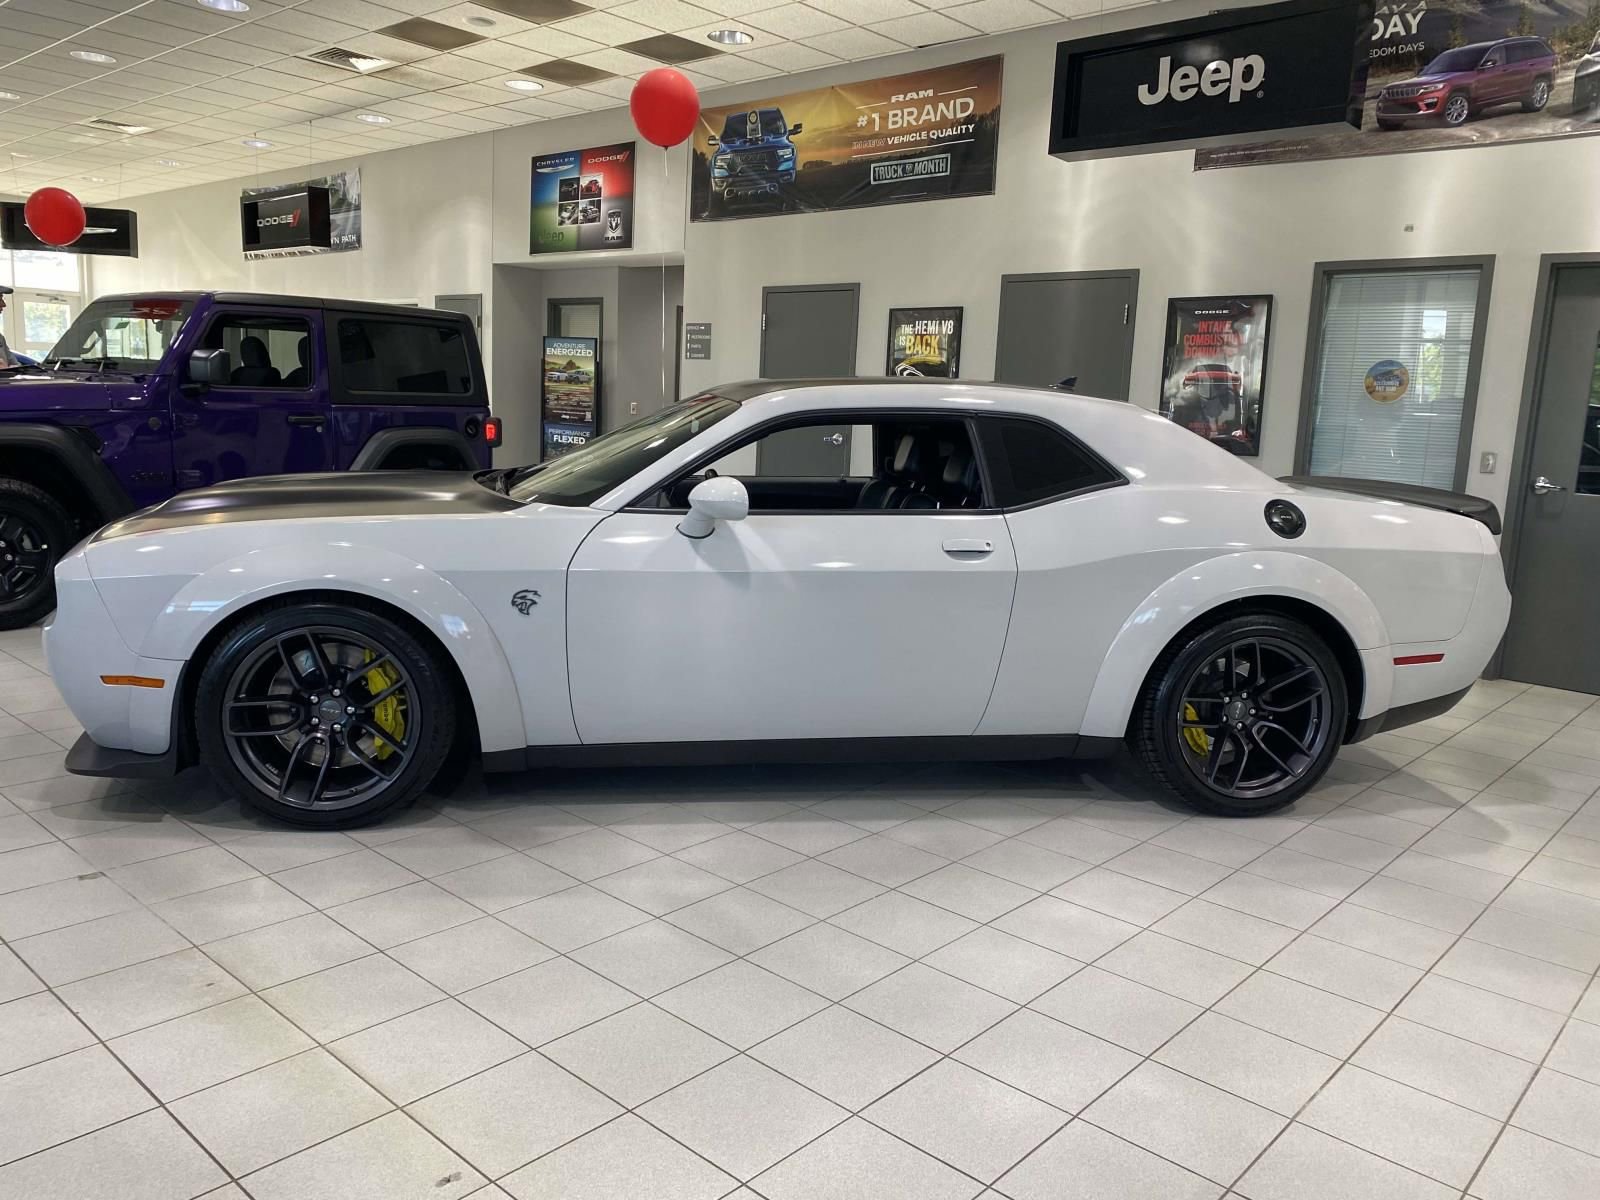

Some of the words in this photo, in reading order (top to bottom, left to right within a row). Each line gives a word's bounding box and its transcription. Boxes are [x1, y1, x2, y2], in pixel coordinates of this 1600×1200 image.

[1371, 10, 1426, 40] DAY
[1369, 46, 1396, 58] EDOM
[1398, 41, 1425, 54] DAYS
[1138, 54, 1265, 105] Jeep
[890, 89, 934, 103] RAM
[888, 97, 975, 130] BRAND
[887, 131, 928, 145] VEHICLE
[930, 124, 975, 139] QUALITY
[587, 154, 625, 164] DODGE
[874, 164, 903, 181] TRUCK
[914, 158, 947, 175] MONTH
[256, 214, 294, 227] DODGE
[341, 234, 357, 244] PATH
[901, 324, 914, 335] THE
[915, 320, 939, 335] HEMI
[941, 320, 954, 335] V8
[1199, 320, 1233, 333] INTAKE
[546, 347, 593, 357] ENERGIZED
[899, 336, 906, 346] IS
[905, 335, 940, 355] BACK
[548, 429, 591, 437] PERFORMANCE
[553, 435, 586, 445] FLEXED
